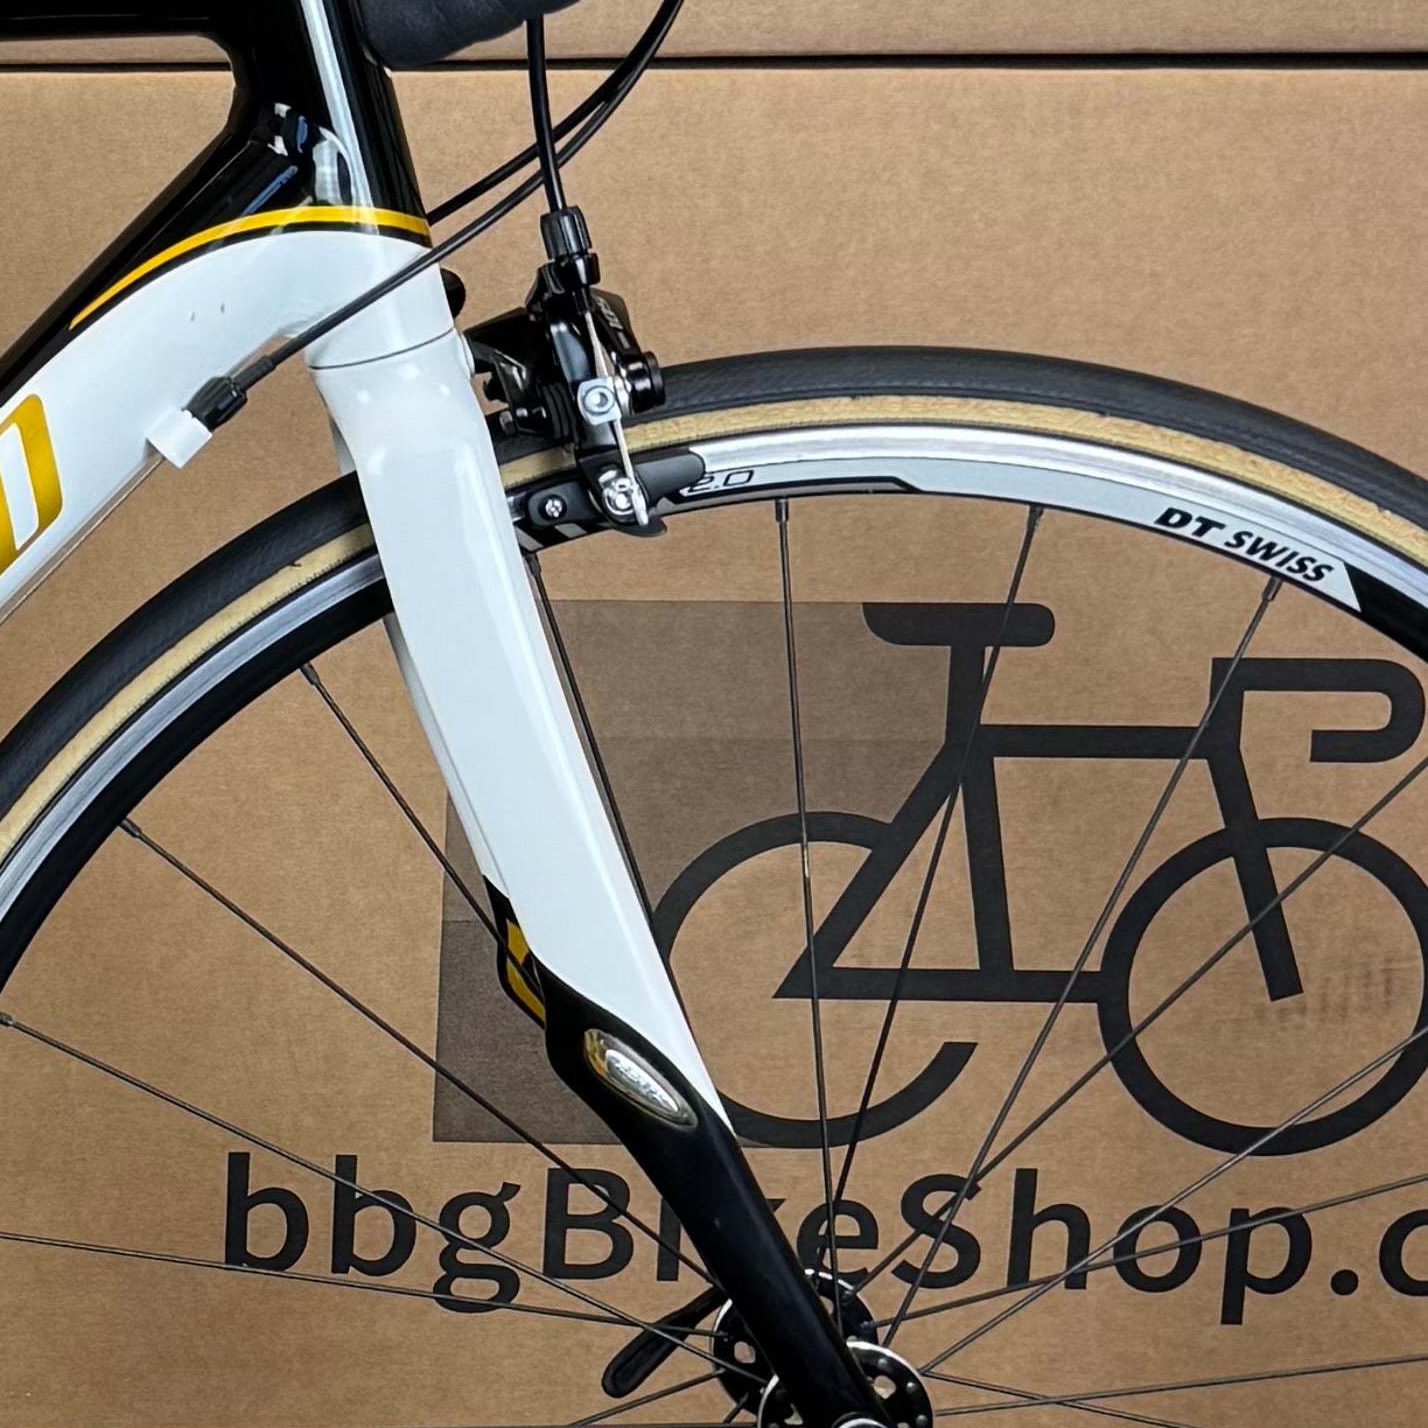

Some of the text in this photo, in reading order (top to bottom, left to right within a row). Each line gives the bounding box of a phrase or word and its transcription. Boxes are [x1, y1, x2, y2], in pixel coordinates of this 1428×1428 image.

[687, 469, 755, 492] 2.0
[1153, 506, 1335, 583] DT SWISS
[224, 1151, 1428, 1326] bbgBieShop.c
